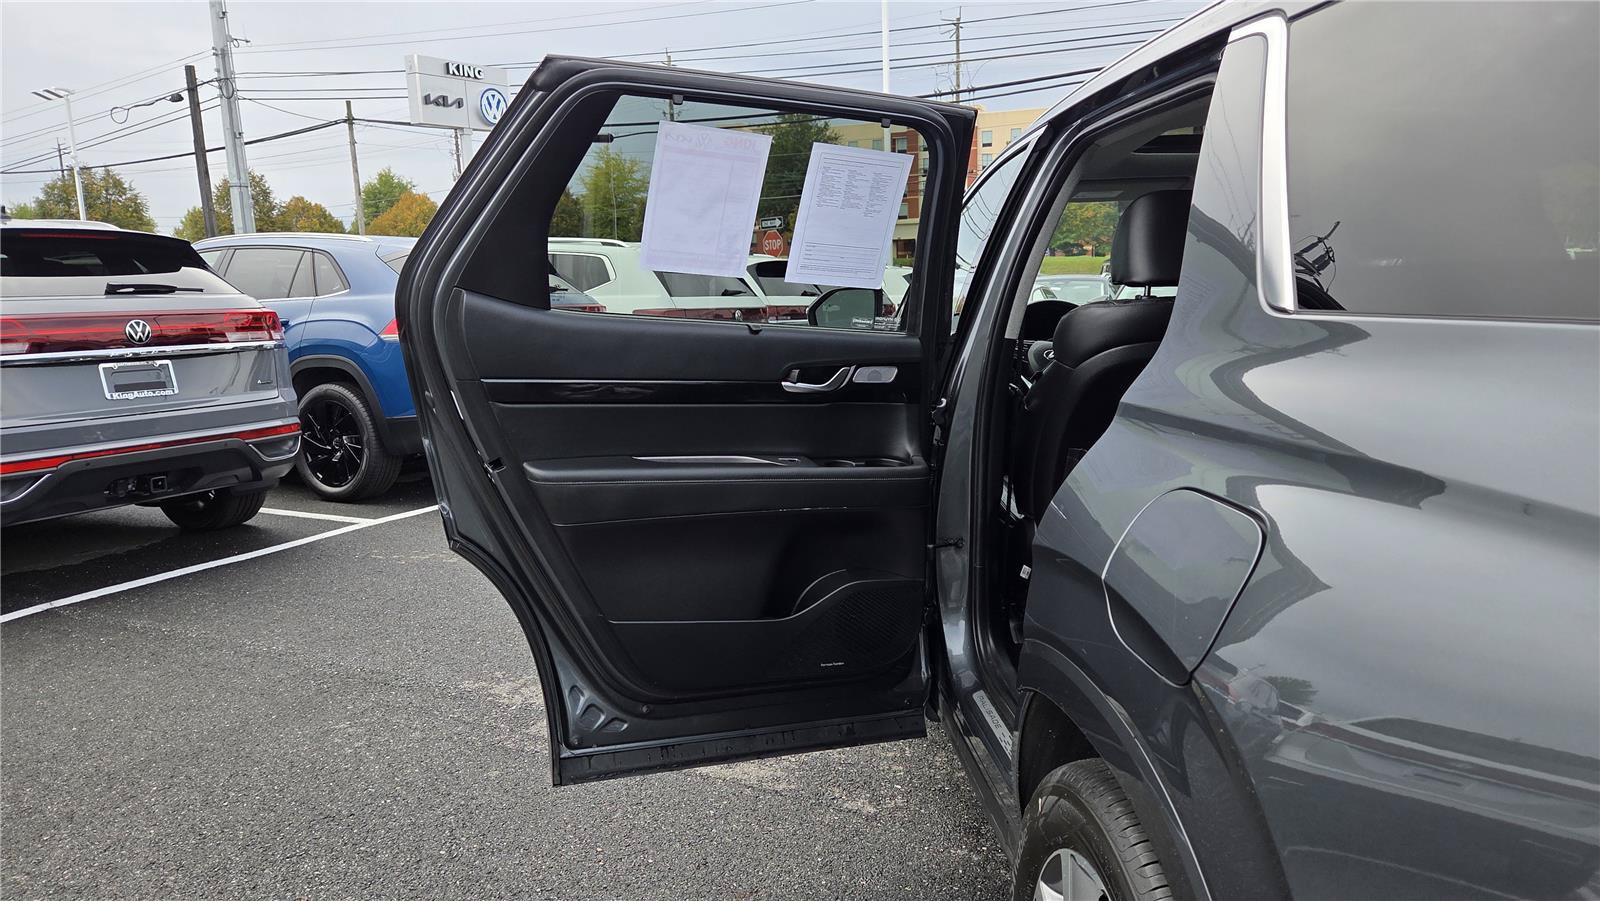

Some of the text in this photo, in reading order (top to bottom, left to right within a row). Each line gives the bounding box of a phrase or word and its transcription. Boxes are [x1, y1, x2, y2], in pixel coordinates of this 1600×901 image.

[445, 62, 485, 79] KING
[764, 240, 781, 251] STOP
[112, 390, 174, 399] KingAuto.com
